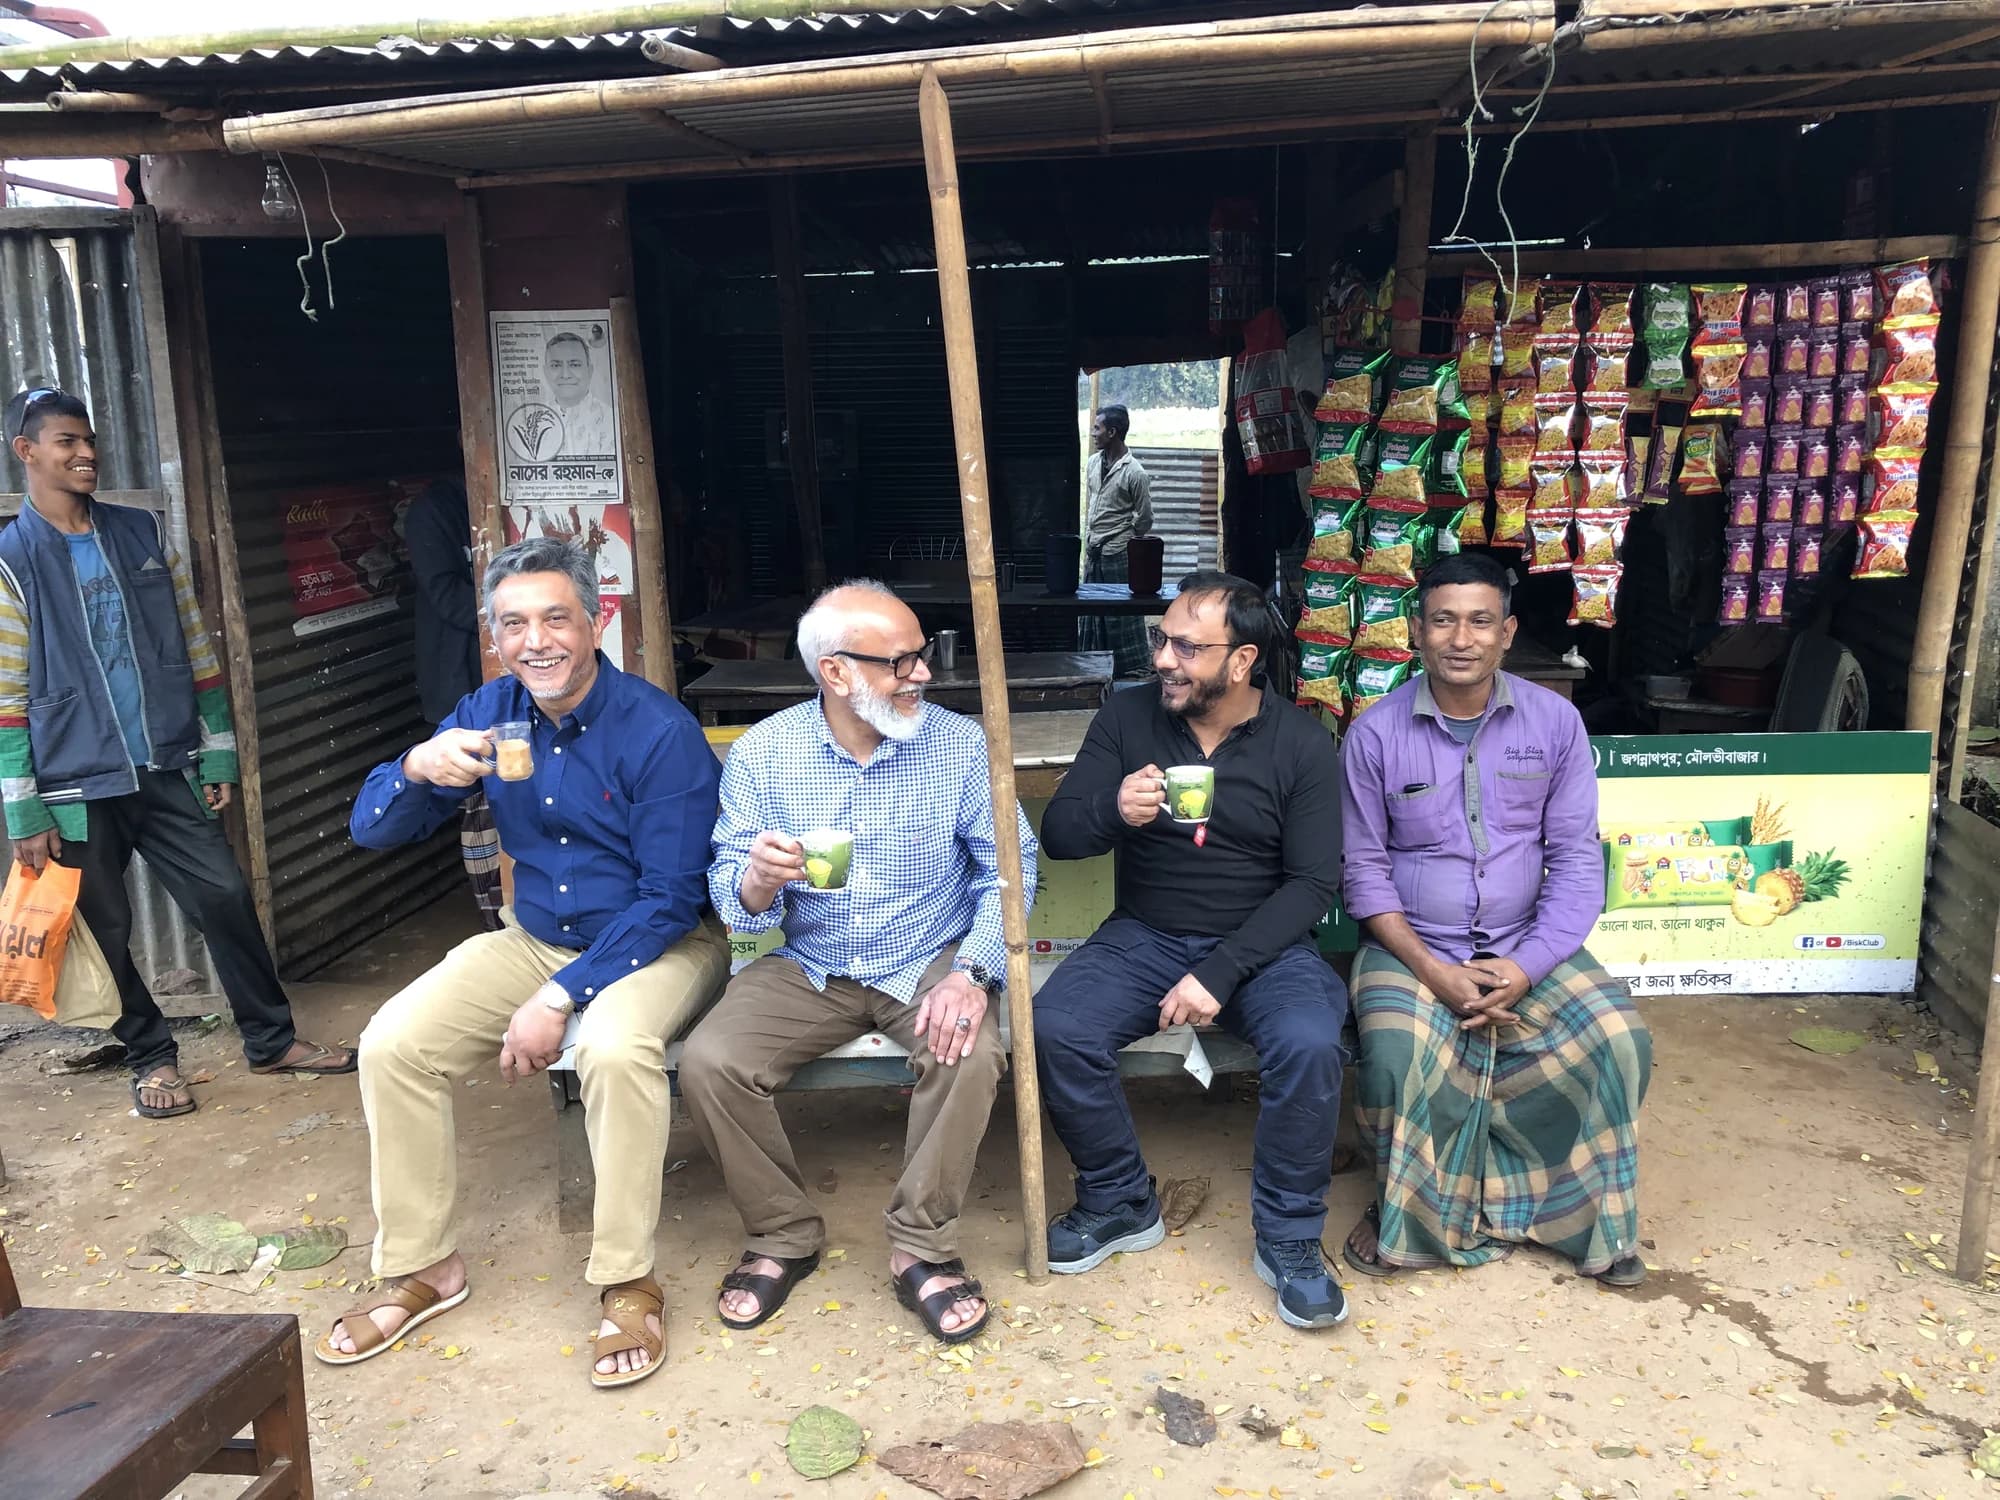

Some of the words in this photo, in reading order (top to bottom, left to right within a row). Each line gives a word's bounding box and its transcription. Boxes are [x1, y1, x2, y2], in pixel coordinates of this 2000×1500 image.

[509, 465, 548, 481] নাসের
[552, 464, 614, 481] রহমান-কে
[287, 500, 328, 524] Rally
[1598, 920, 1628, 932] ভালো
[1661, 918, 1691, 929] ভালো
[1695, 917, 1726, 932] থাকুন
[1843, 939, 1879, 947] /BiskClub
[1645, 974, 1675, 988] জন্য
[1679, 969, 1732, 987] ক্ষতিকর
